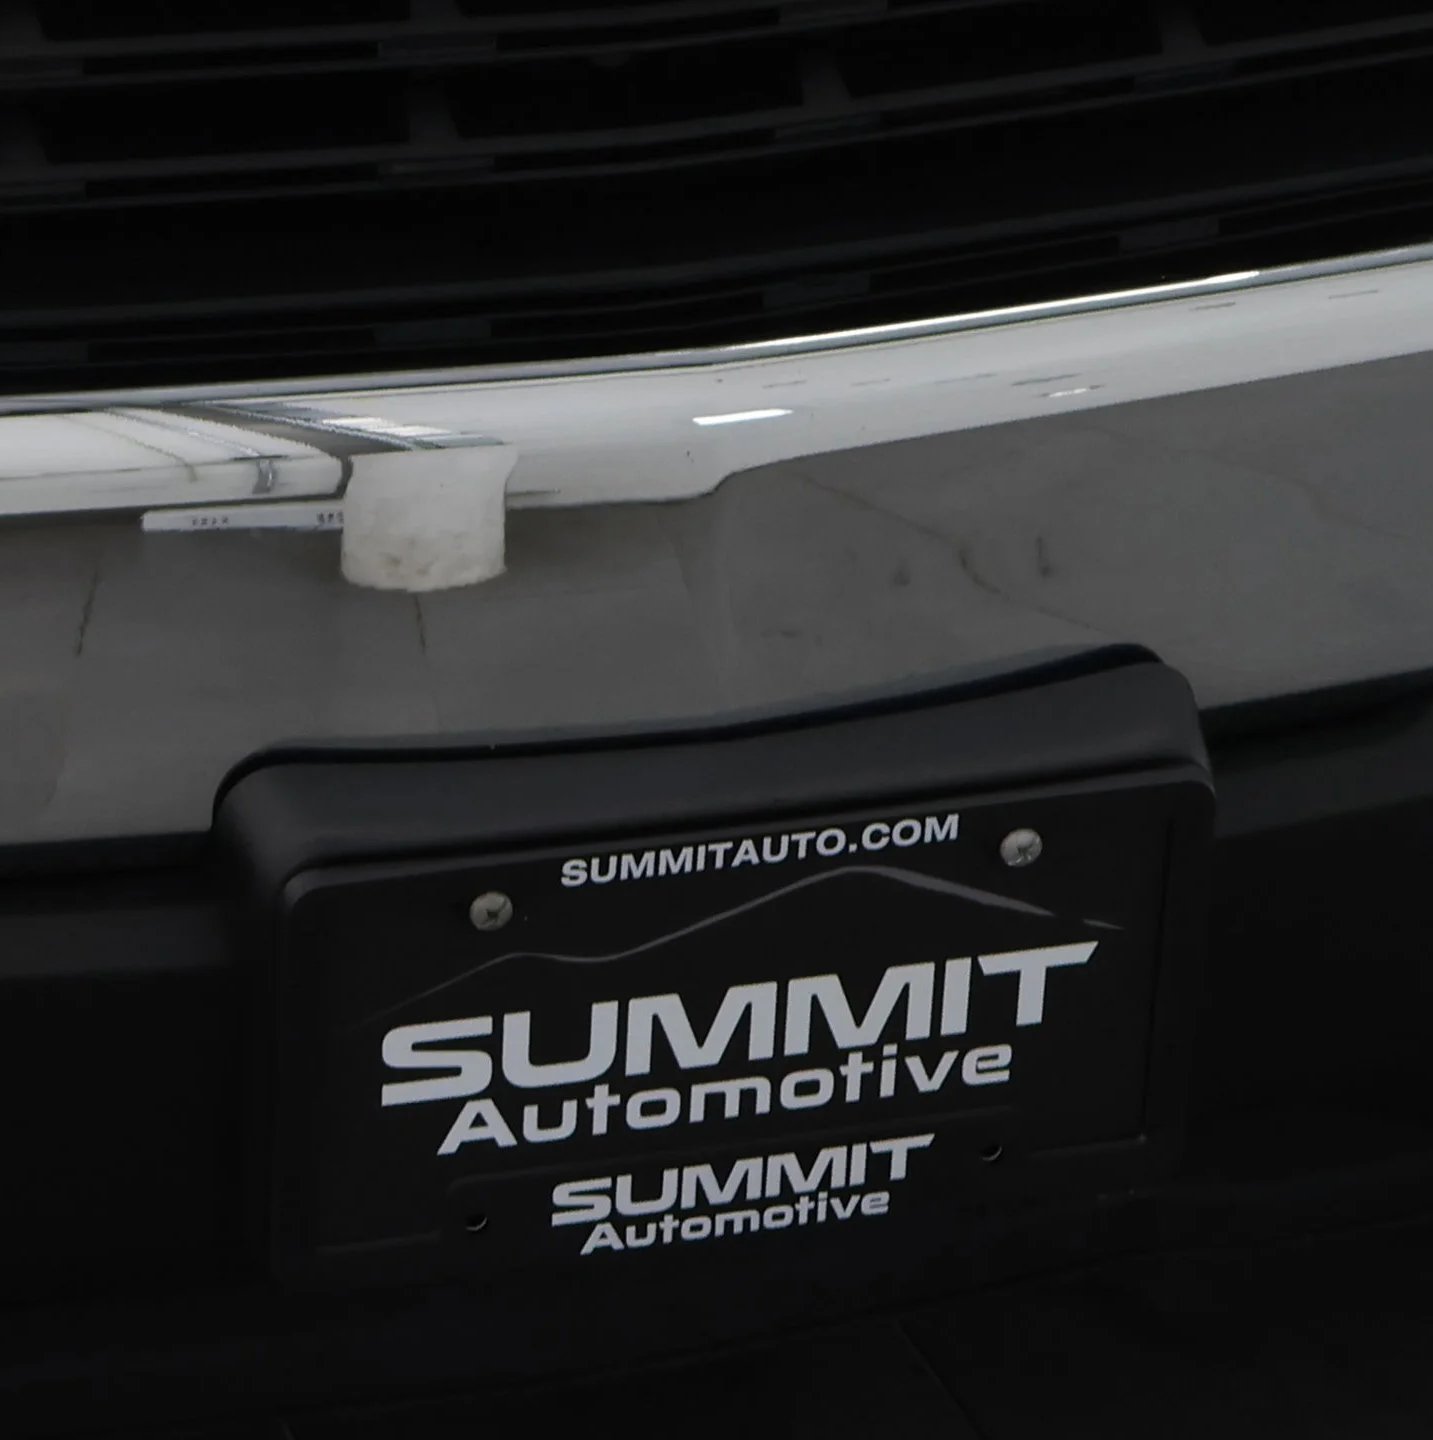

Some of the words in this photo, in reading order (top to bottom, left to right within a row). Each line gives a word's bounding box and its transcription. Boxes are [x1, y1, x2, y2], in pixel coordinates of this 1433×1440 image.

[559, 812, 961, 887] SUMMITAUTO.COM
[380, 940, 1100, 1107] SUMMIT
[436, 1042, 1013, 1156] Automotive
[550, 1132, 936, 1227] SUMMIT
[579, 1190, 891, 1256] Automotive
